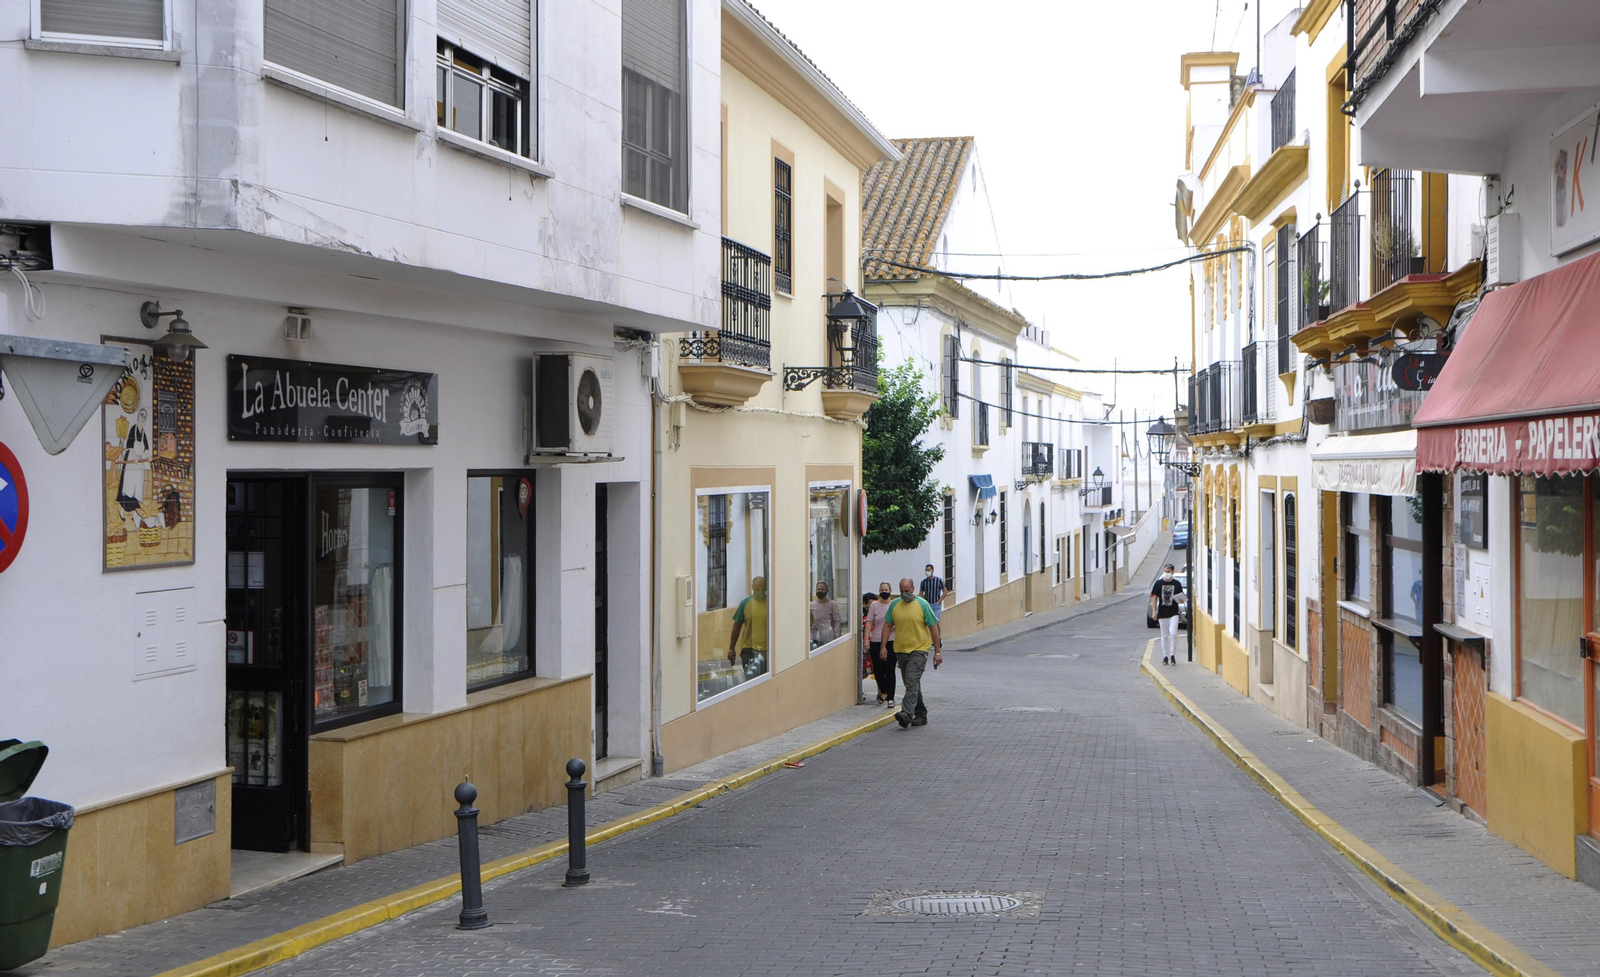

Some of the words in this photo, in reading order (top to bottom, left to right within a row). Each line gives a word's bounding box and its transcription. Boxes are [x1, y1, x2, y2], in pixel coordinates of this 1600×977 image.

[1414, 357, 1425, 368] La
[1424, 371, 1437, 385] Viu
[241, 363, 265, 419] La
[271, 370, 331, 411] Abuela
[335, 377, 390, 424] Center
[323, 425, 380, 438] Confiteria
[1455, 426, 1507, 464] LIBRERIA
[1528, 415, 1600, 460] PAPELERI
[321, 510, 348, 558] Horno
